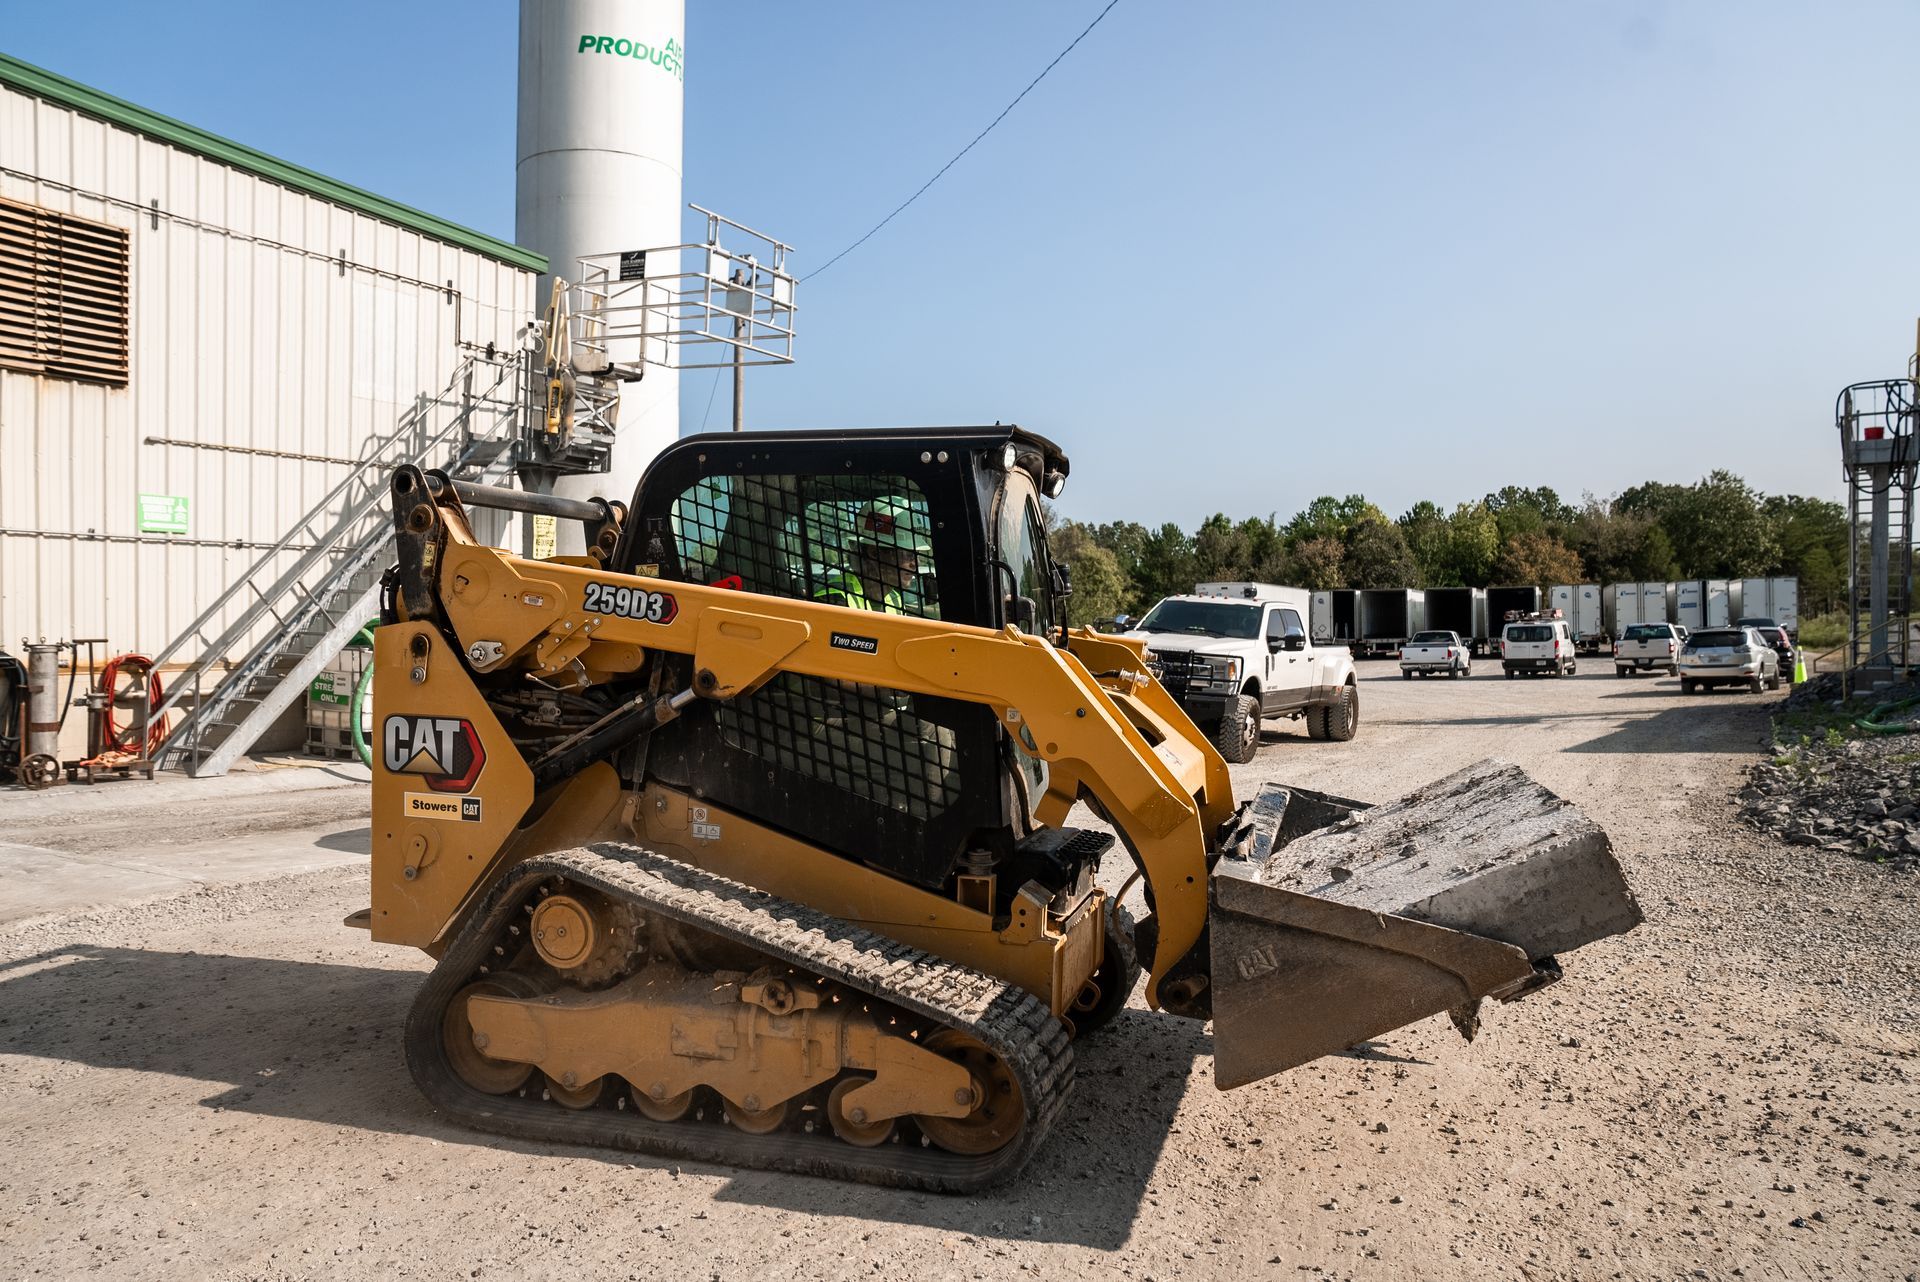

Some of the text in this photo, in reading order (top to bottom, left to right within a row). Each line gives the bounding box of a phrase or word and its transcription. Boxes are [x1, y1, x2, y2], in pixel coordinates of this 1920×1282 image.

[584, 583, 664, 621] 259D3
[320, 672, 334, 681] WAS
[314, 682, 334, 691] STRE
[320, 693, 338, 703] ONLY
[385, 716, 460, 774] CAT
[412, 799, 479, 816] Stowers CAT
[1236, 944, 1279, 980] CAT
